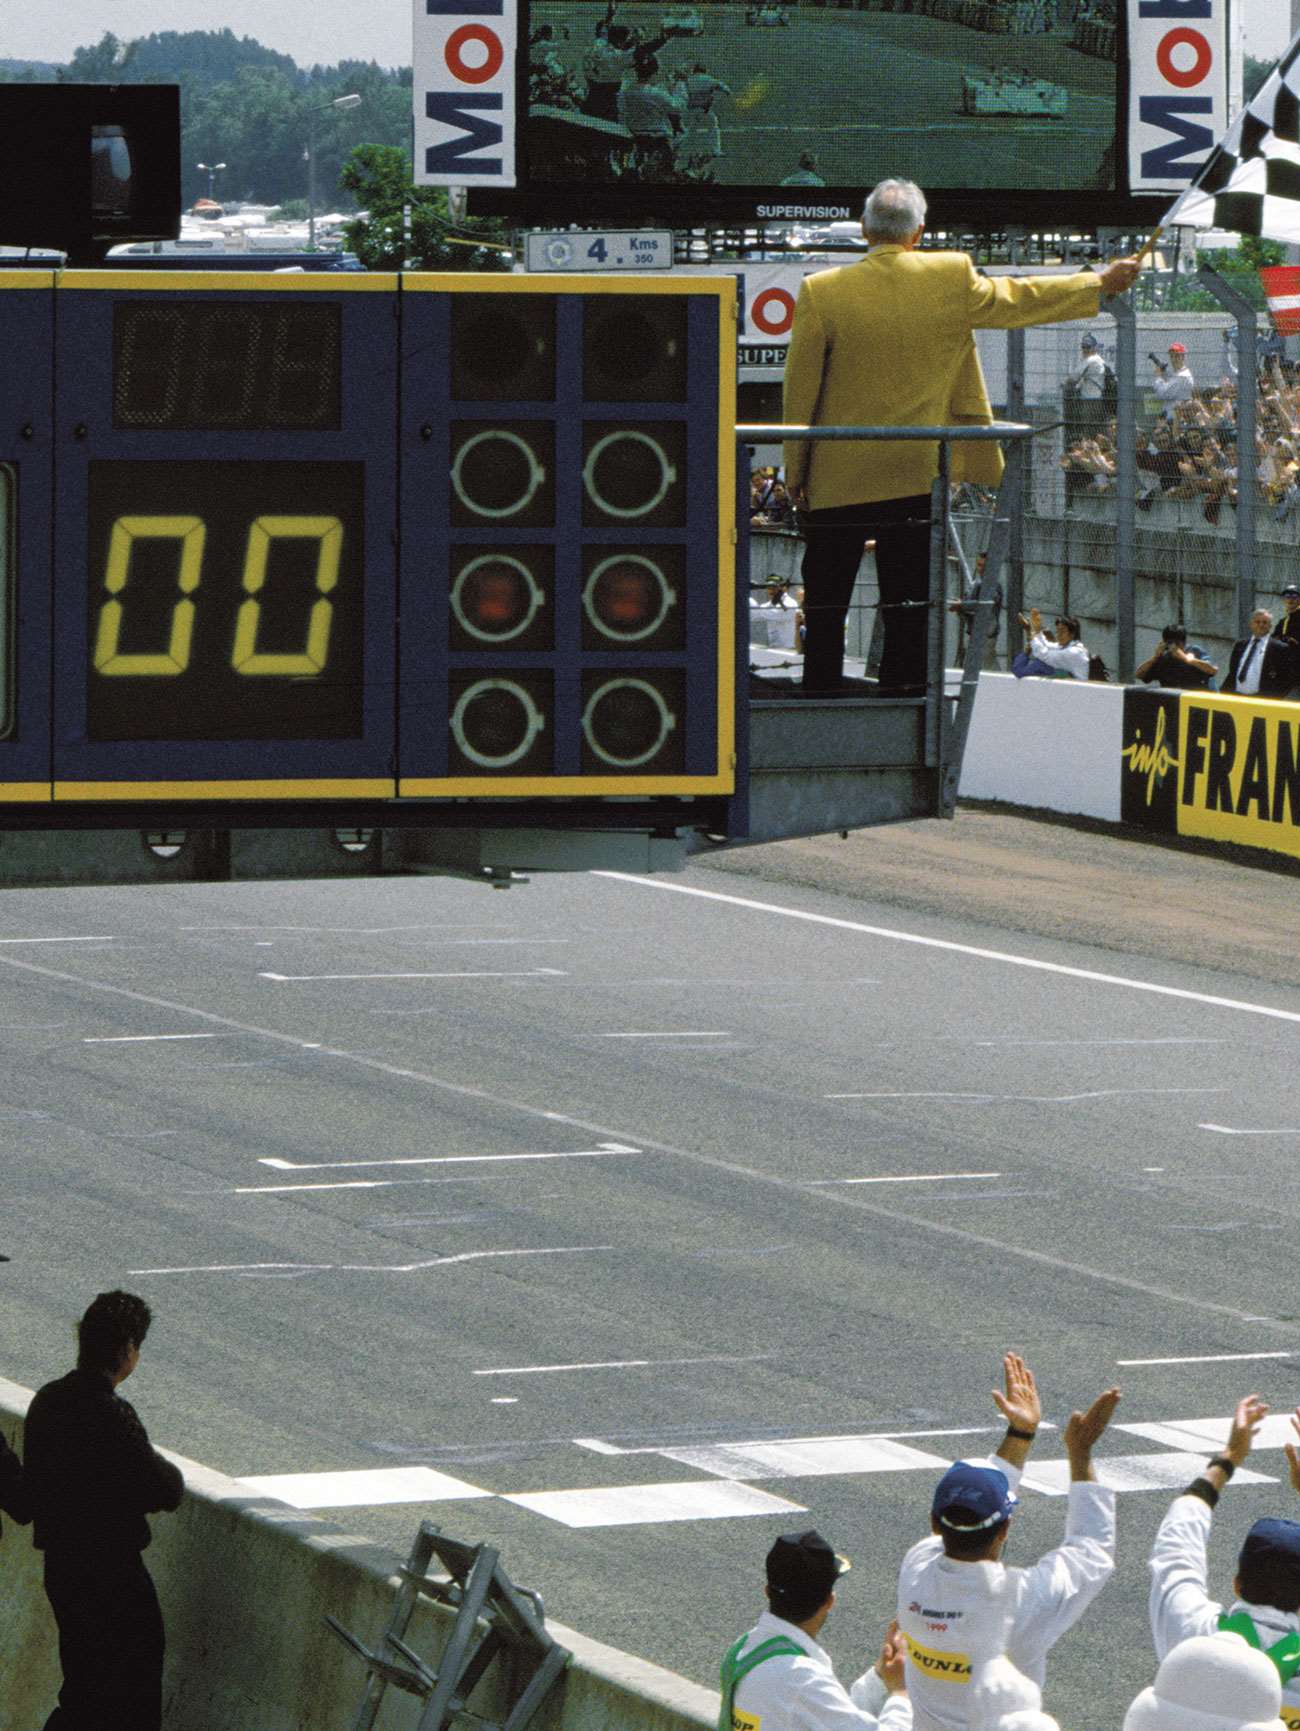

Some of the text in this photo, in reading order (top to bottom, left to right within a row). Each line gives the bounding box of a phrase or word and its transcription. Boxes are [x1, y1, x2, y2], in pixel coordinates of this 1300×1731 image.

[425, 0, 504, 175] Mo
[629, 238, 659, 250] Kms
[756, 205, 850, 218] SUPERVISION
[94, 516, 343, 676] 00
[1121, 706, 1178, 806] info
